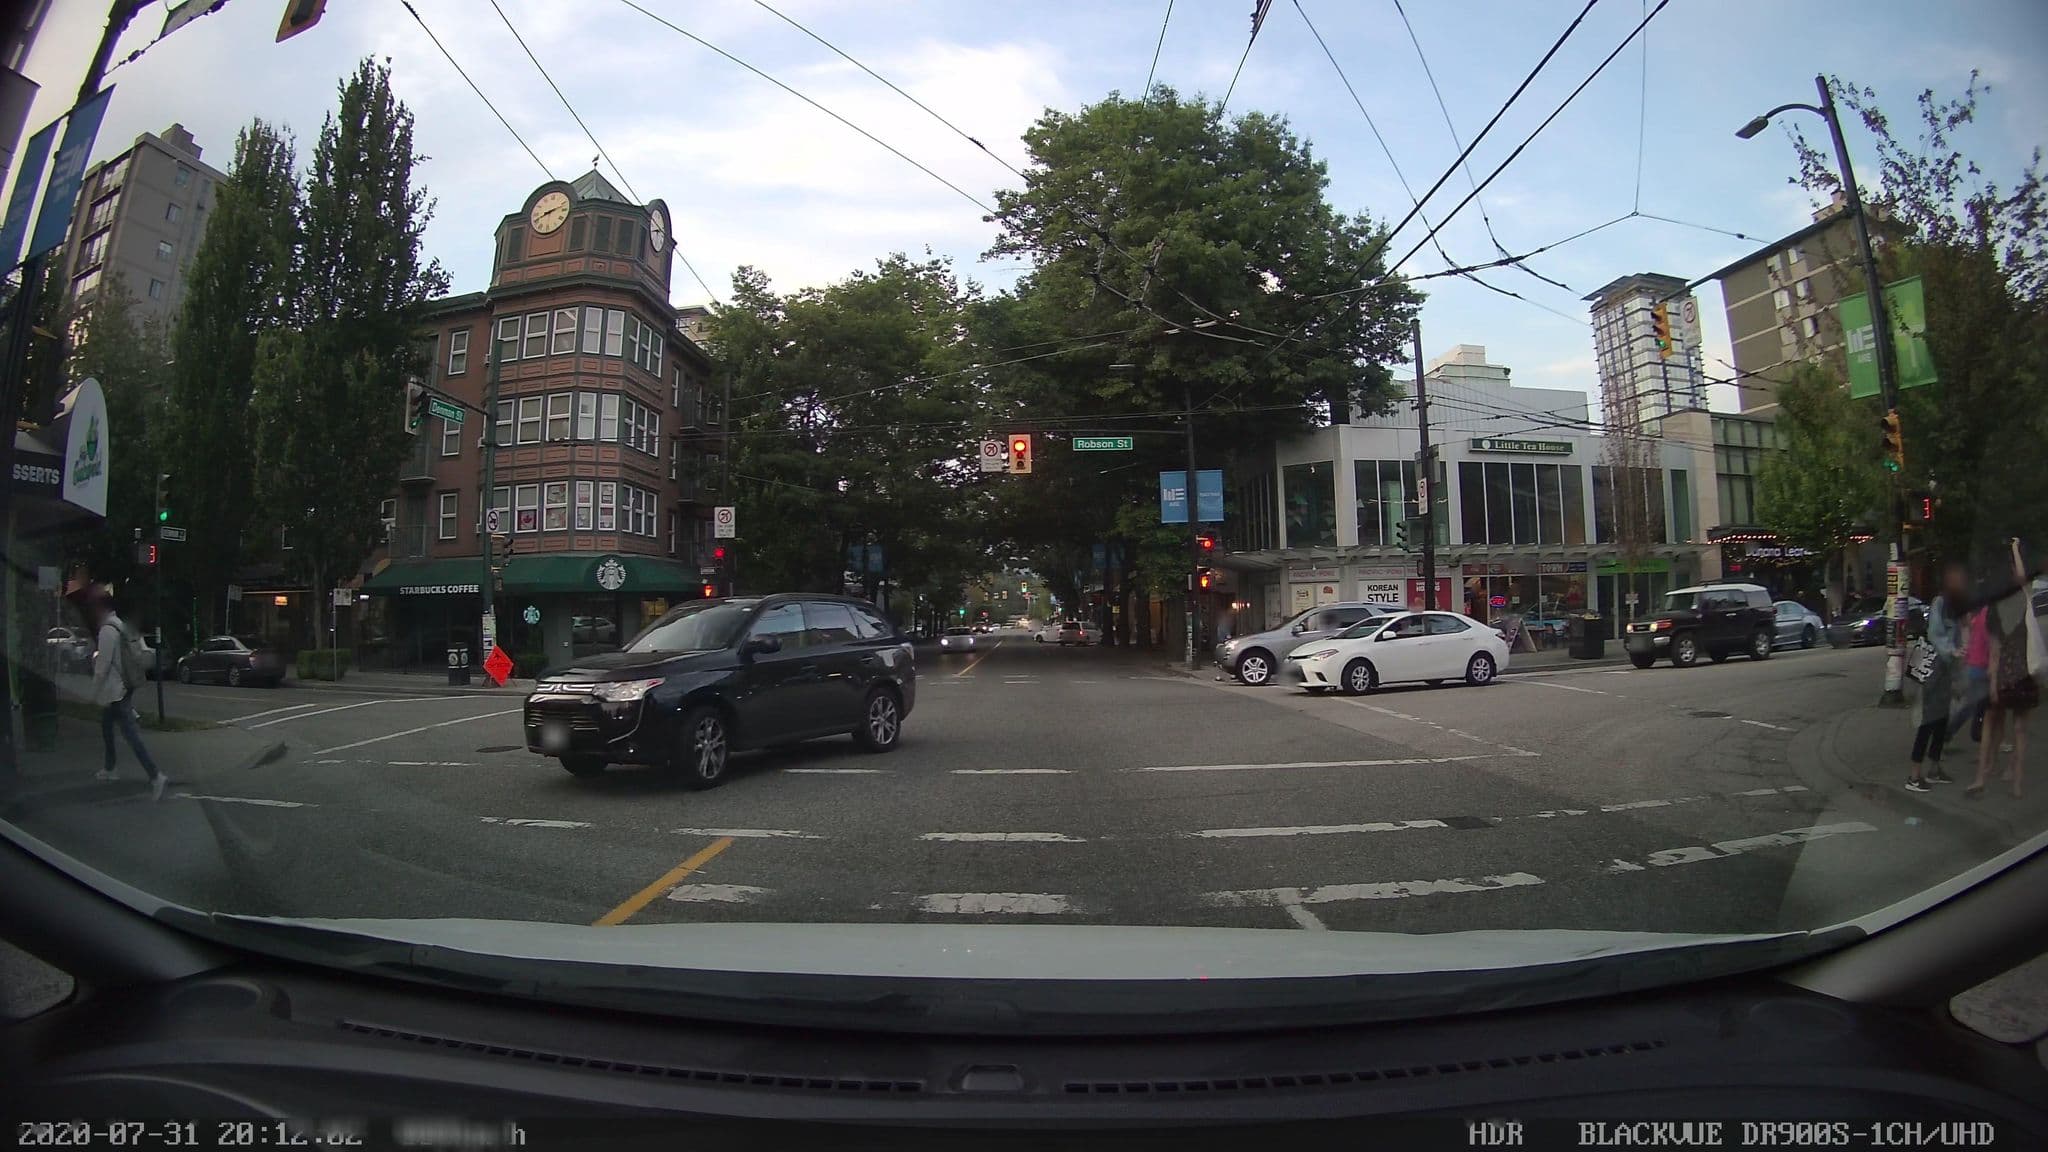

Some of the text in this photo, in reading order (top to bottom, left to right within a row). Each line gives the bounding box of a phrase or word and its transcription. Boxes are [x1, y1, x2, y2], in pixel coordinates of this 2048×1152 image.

[1077, 440, 1128, 449] Robson St
[1495, 440, 1564, 452] Little Tea House
[149, 545, 156, 563] 3
[400, 584, 479, 595] STARBUCKS COFFEE
[1367, 584, 1399, 592] KOREAN
[1367, 593, 1399, 603] STYLE
